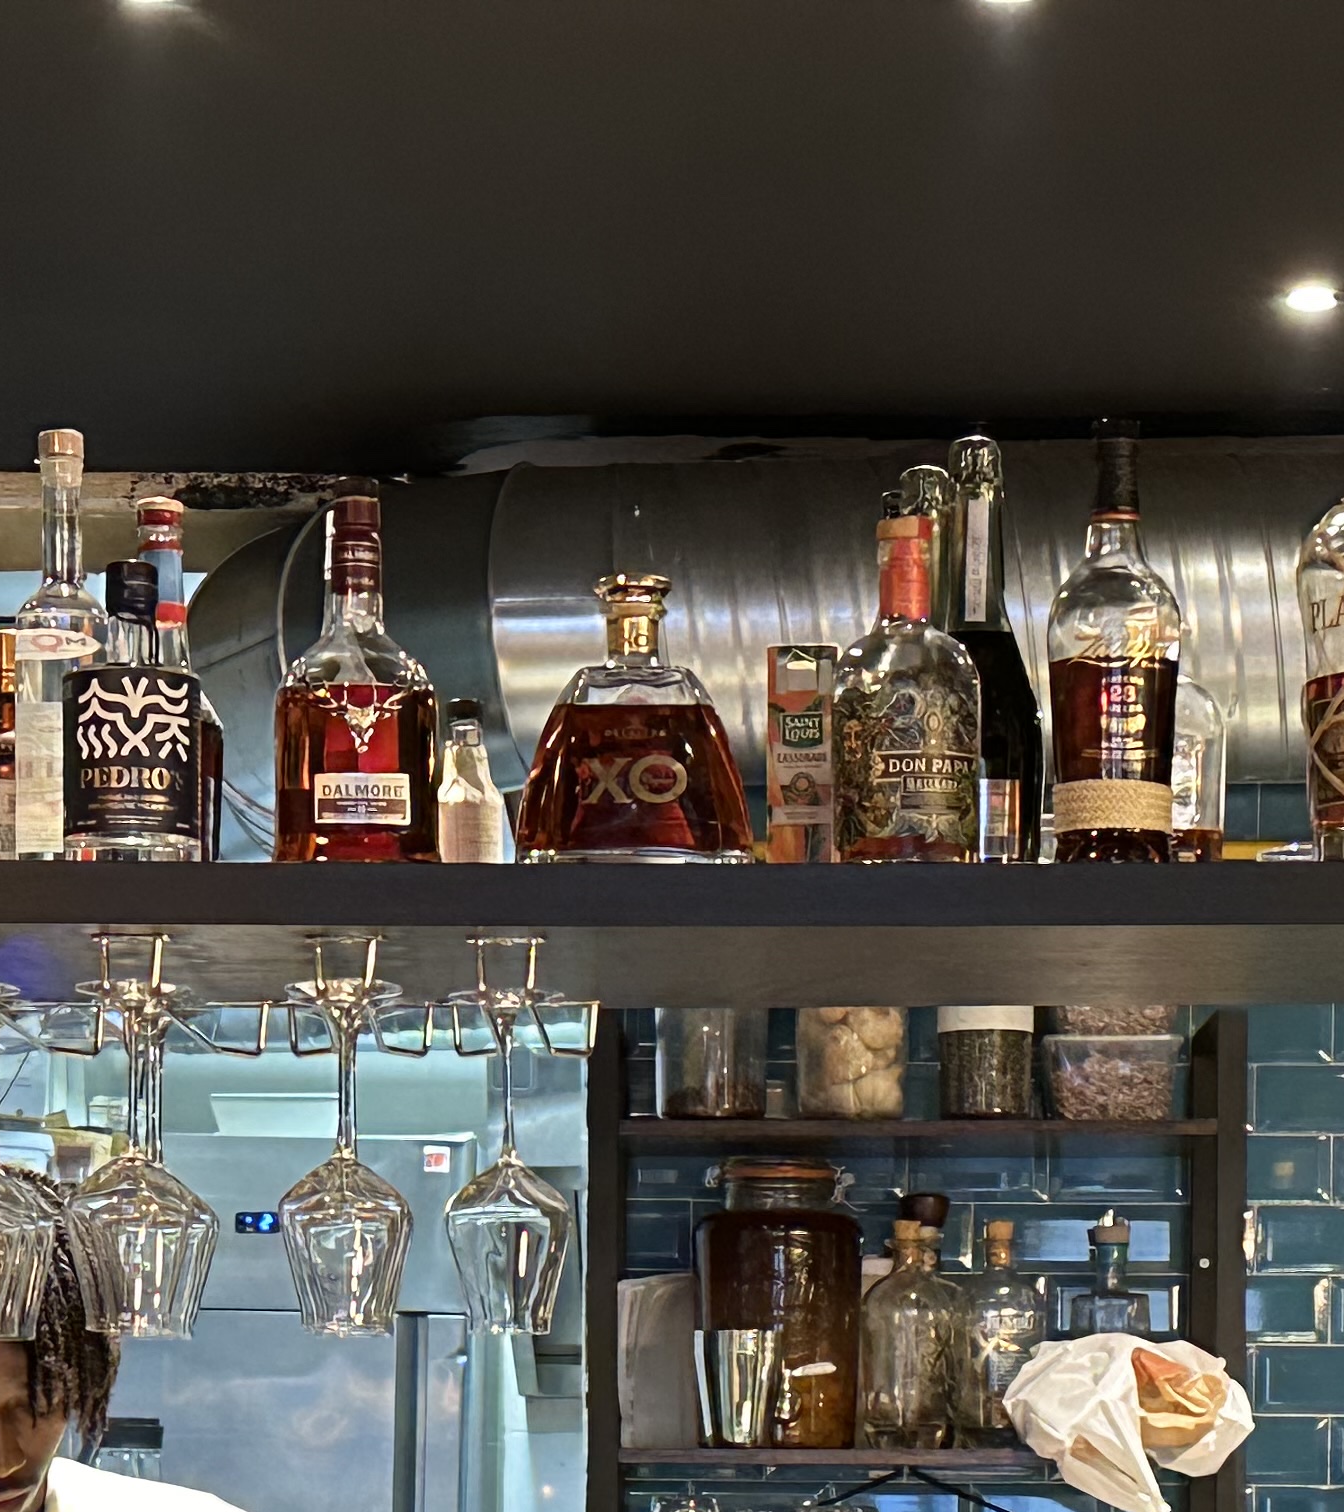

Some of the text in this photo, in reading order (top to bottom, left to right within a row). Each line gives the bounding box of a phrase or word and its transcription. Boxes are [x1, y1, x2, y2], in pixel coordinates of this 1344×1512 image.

[888, 757, 927, 773] DON
[582, 754, 688, 804] XO
[321, 784, 405, 798] DALMORE
